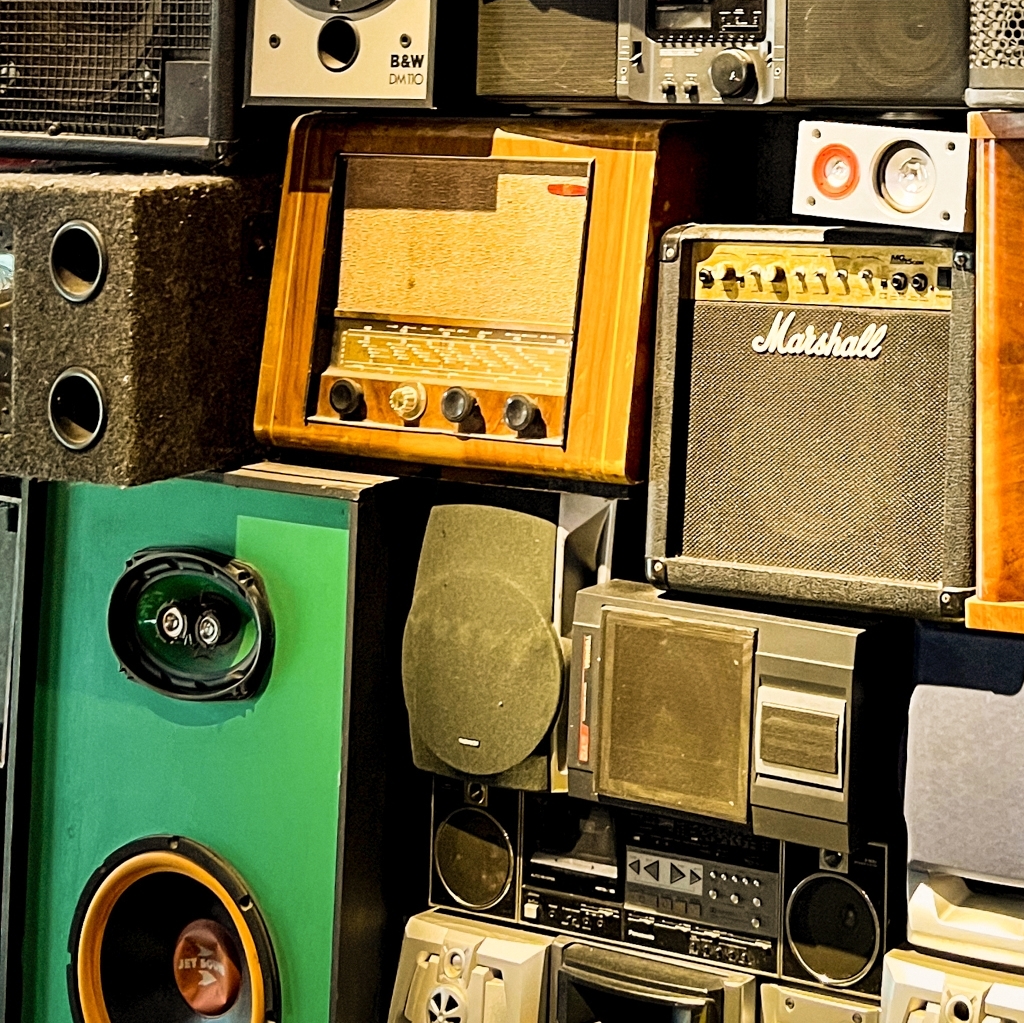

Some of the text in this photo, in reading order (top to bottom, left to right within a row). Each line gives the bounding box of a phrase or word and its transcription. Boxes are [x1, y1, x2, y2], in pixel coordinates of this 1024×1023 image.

[390, 54, 425, 68] B&W
[751, 310, 888, 360] Marshall
[178, 957, 198, 970] JET
